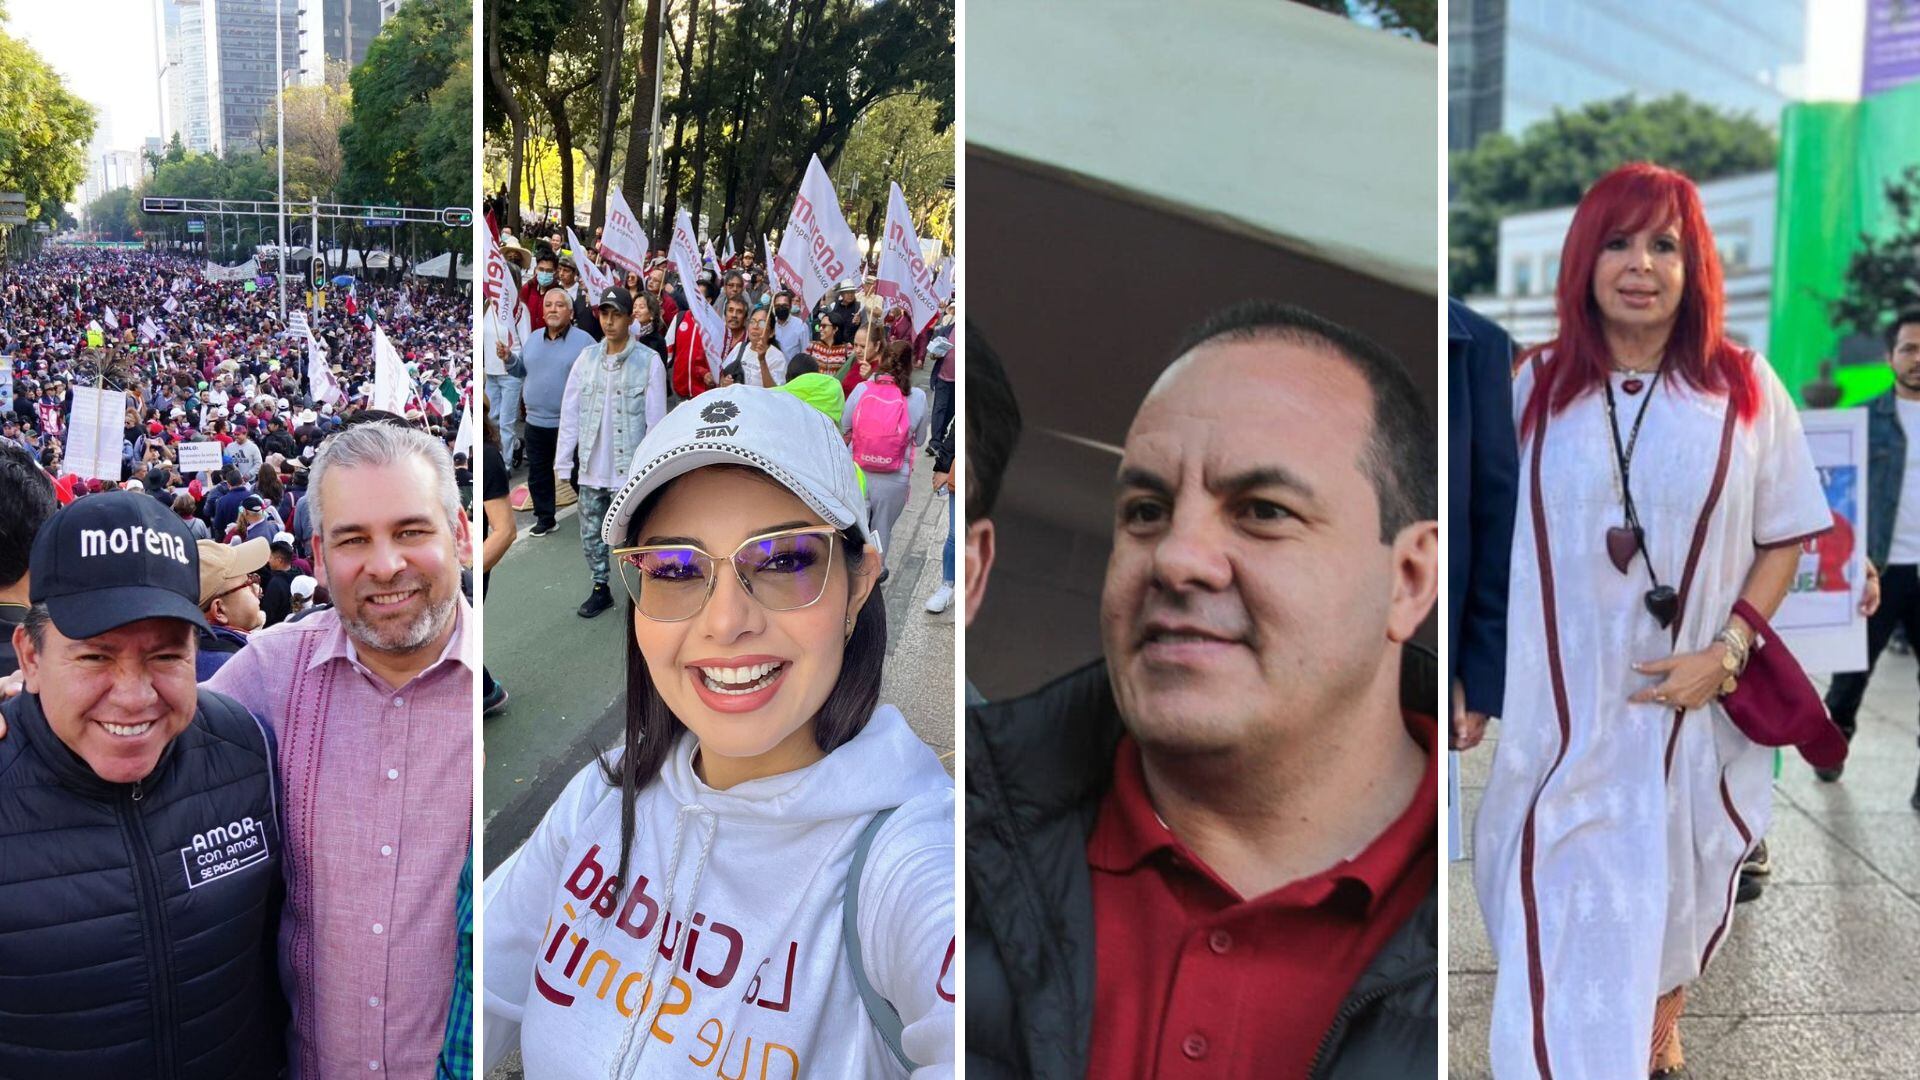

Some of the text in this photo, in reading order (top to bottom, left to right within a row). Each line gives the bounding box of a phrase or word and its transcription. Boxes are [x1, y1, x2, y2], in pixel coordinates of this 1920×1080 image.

[792, 192, 845, 282] morena
[81, 526, 189, 564] morena
[192, 817, 255, 852] AMOR
[197, 835, 258, 865] CON AMOR
[200, 858, 240, 879] SE PAGA
